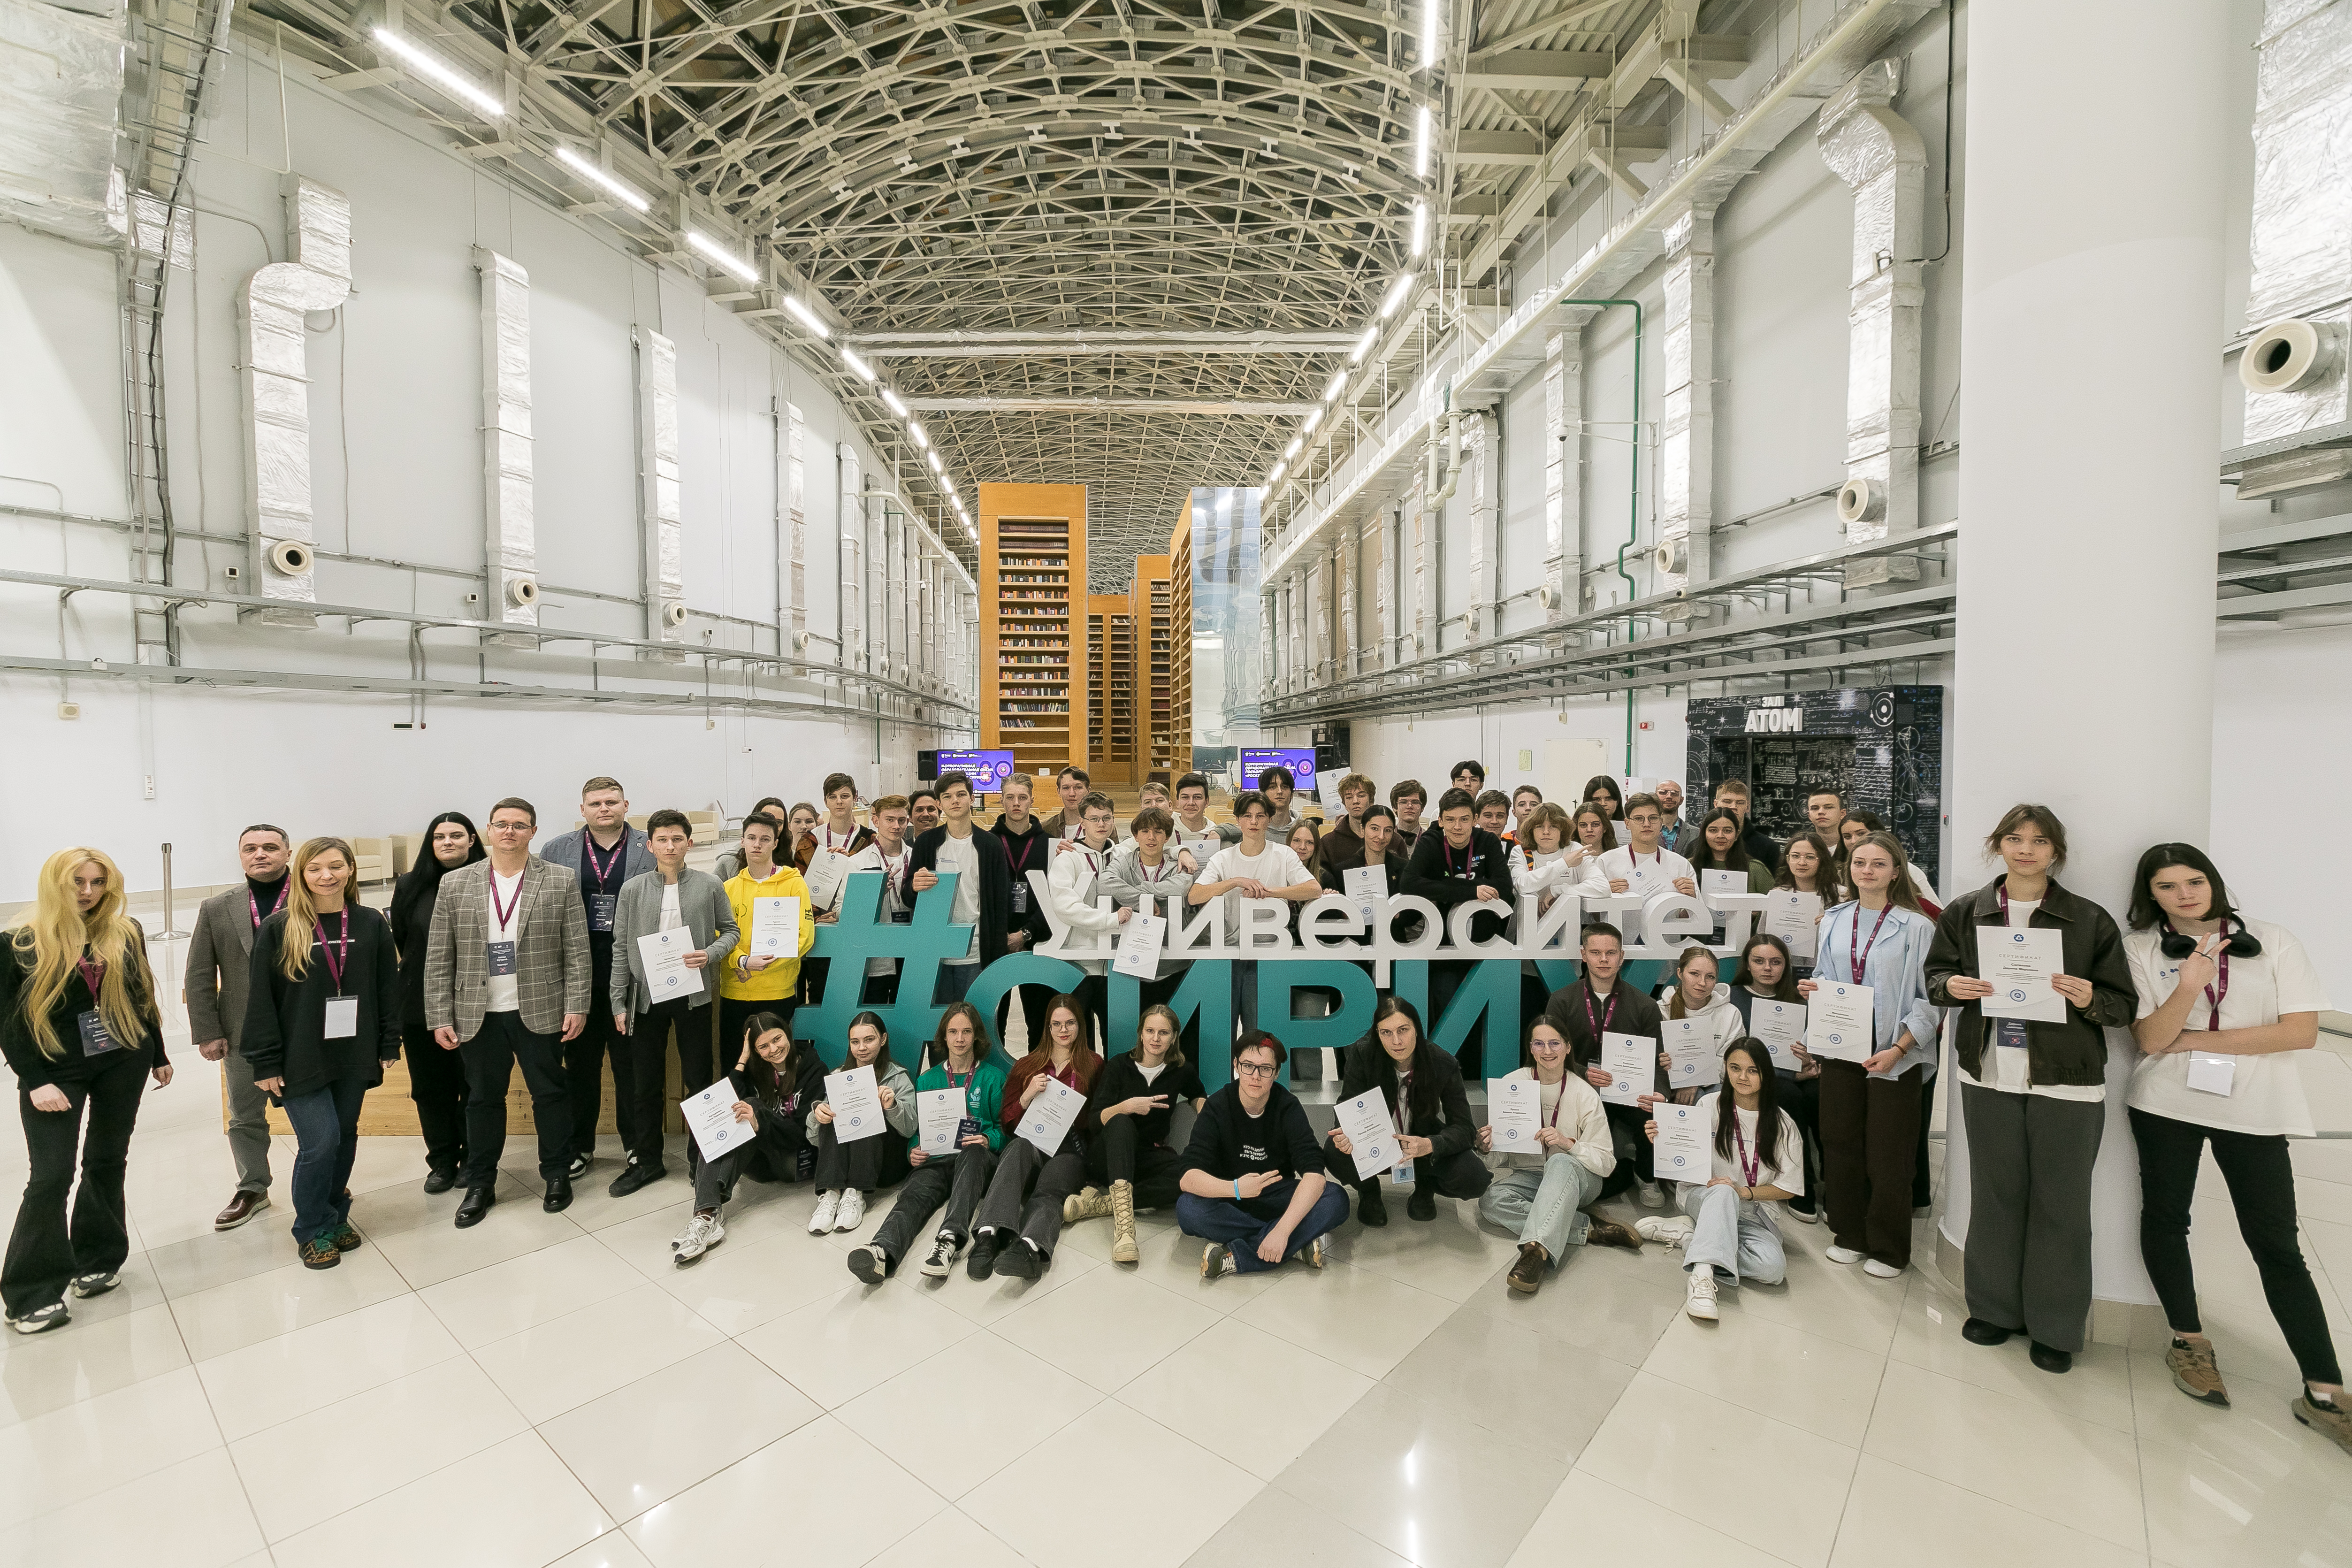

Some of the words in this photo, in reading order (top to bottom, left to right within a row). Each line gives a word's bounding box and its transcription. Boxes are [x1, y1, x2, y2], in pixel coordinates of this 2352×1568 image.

[1762, 696, 1785, 707] ЗАЛ
[1744, 708, 1803, 733] АТОМ
[655, 948, 681, 957] СЕРТИФИКАТ
[840, 1087, 865, 1097] СЕРТИФИКАТ
[700, 1101, 725, 1117] СЕРТИФИКАТ
[1354, 1113, 1378, 1126] СЕРТИФИКАТ
